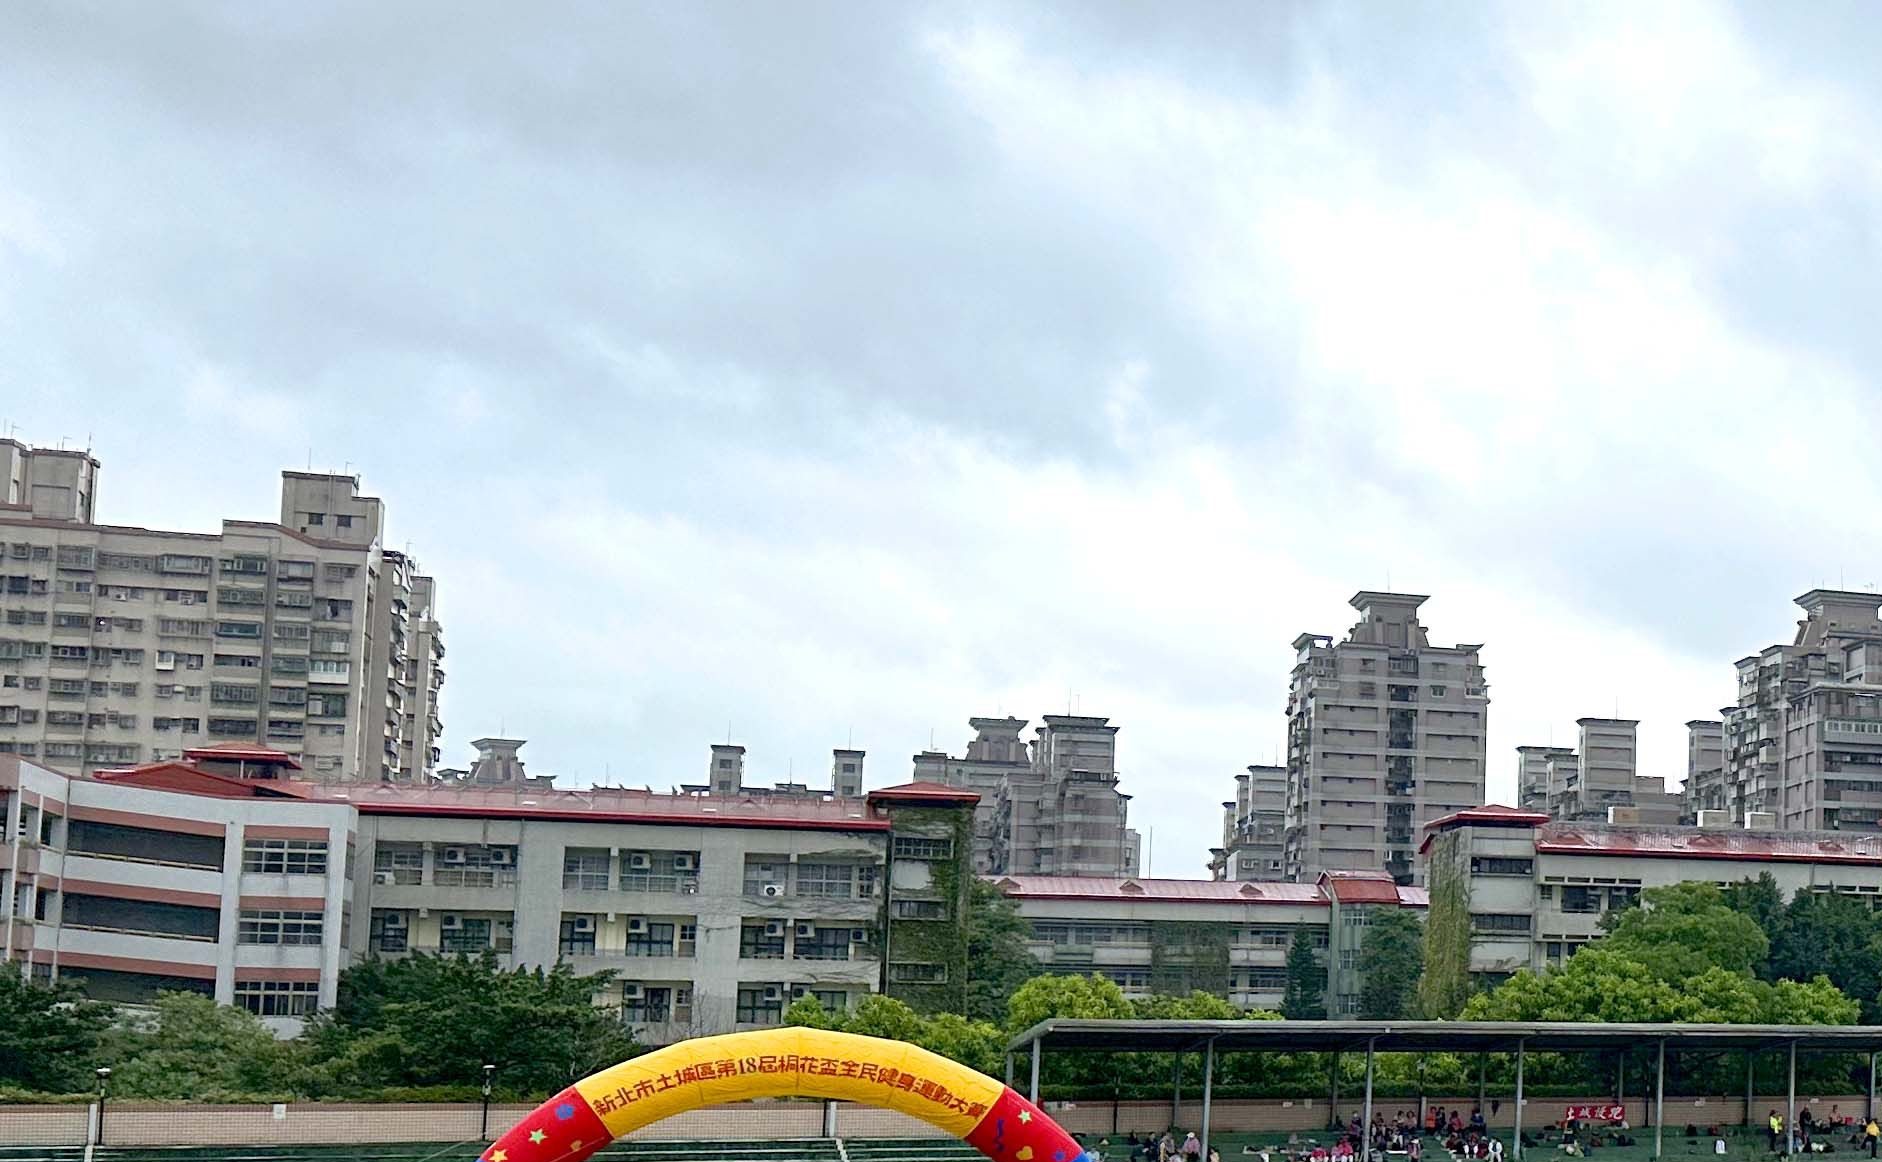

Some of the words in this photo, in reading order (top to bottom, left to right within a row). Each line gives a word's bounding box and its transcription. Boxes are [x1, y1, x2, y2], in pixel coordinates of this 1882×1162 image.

[592, 1054, 990, 1121] 新北市土城區第18屆桐花盃全民健身運動大賽
